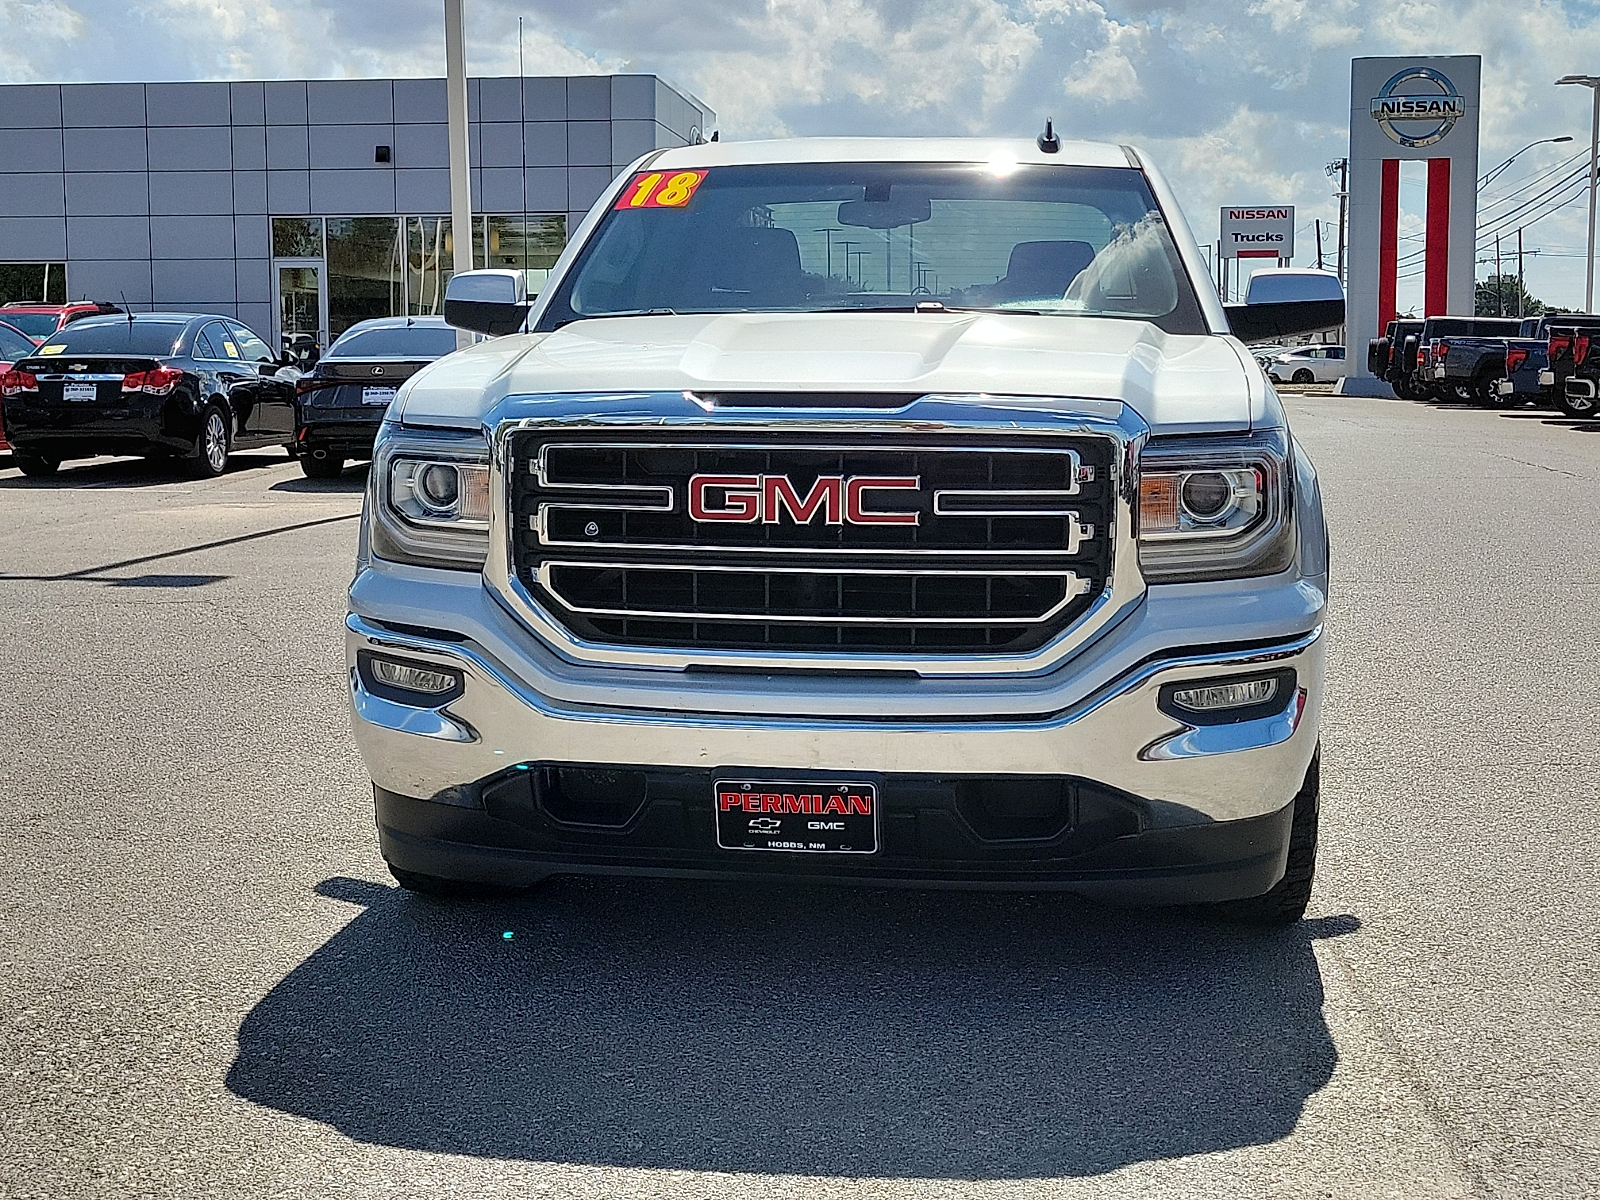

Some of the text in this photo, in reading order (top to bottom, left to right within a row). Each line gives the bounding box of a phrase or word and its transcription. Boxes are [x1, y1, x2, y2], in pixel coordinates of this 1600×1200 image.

[1380, 99, 1457, 114] NISSAN
[630, 172, 701, 207] 18
[1229, 209, 1288, 220] NISSAN
[1231, 232, 1284, 243] Trucks
[688, 473, 921, 527] GMC
[719, 792, 871, 815] PERMIAN
[807, 822, 845, 830] GMC
[767, 840, 826, 850] HOBBS, NM
